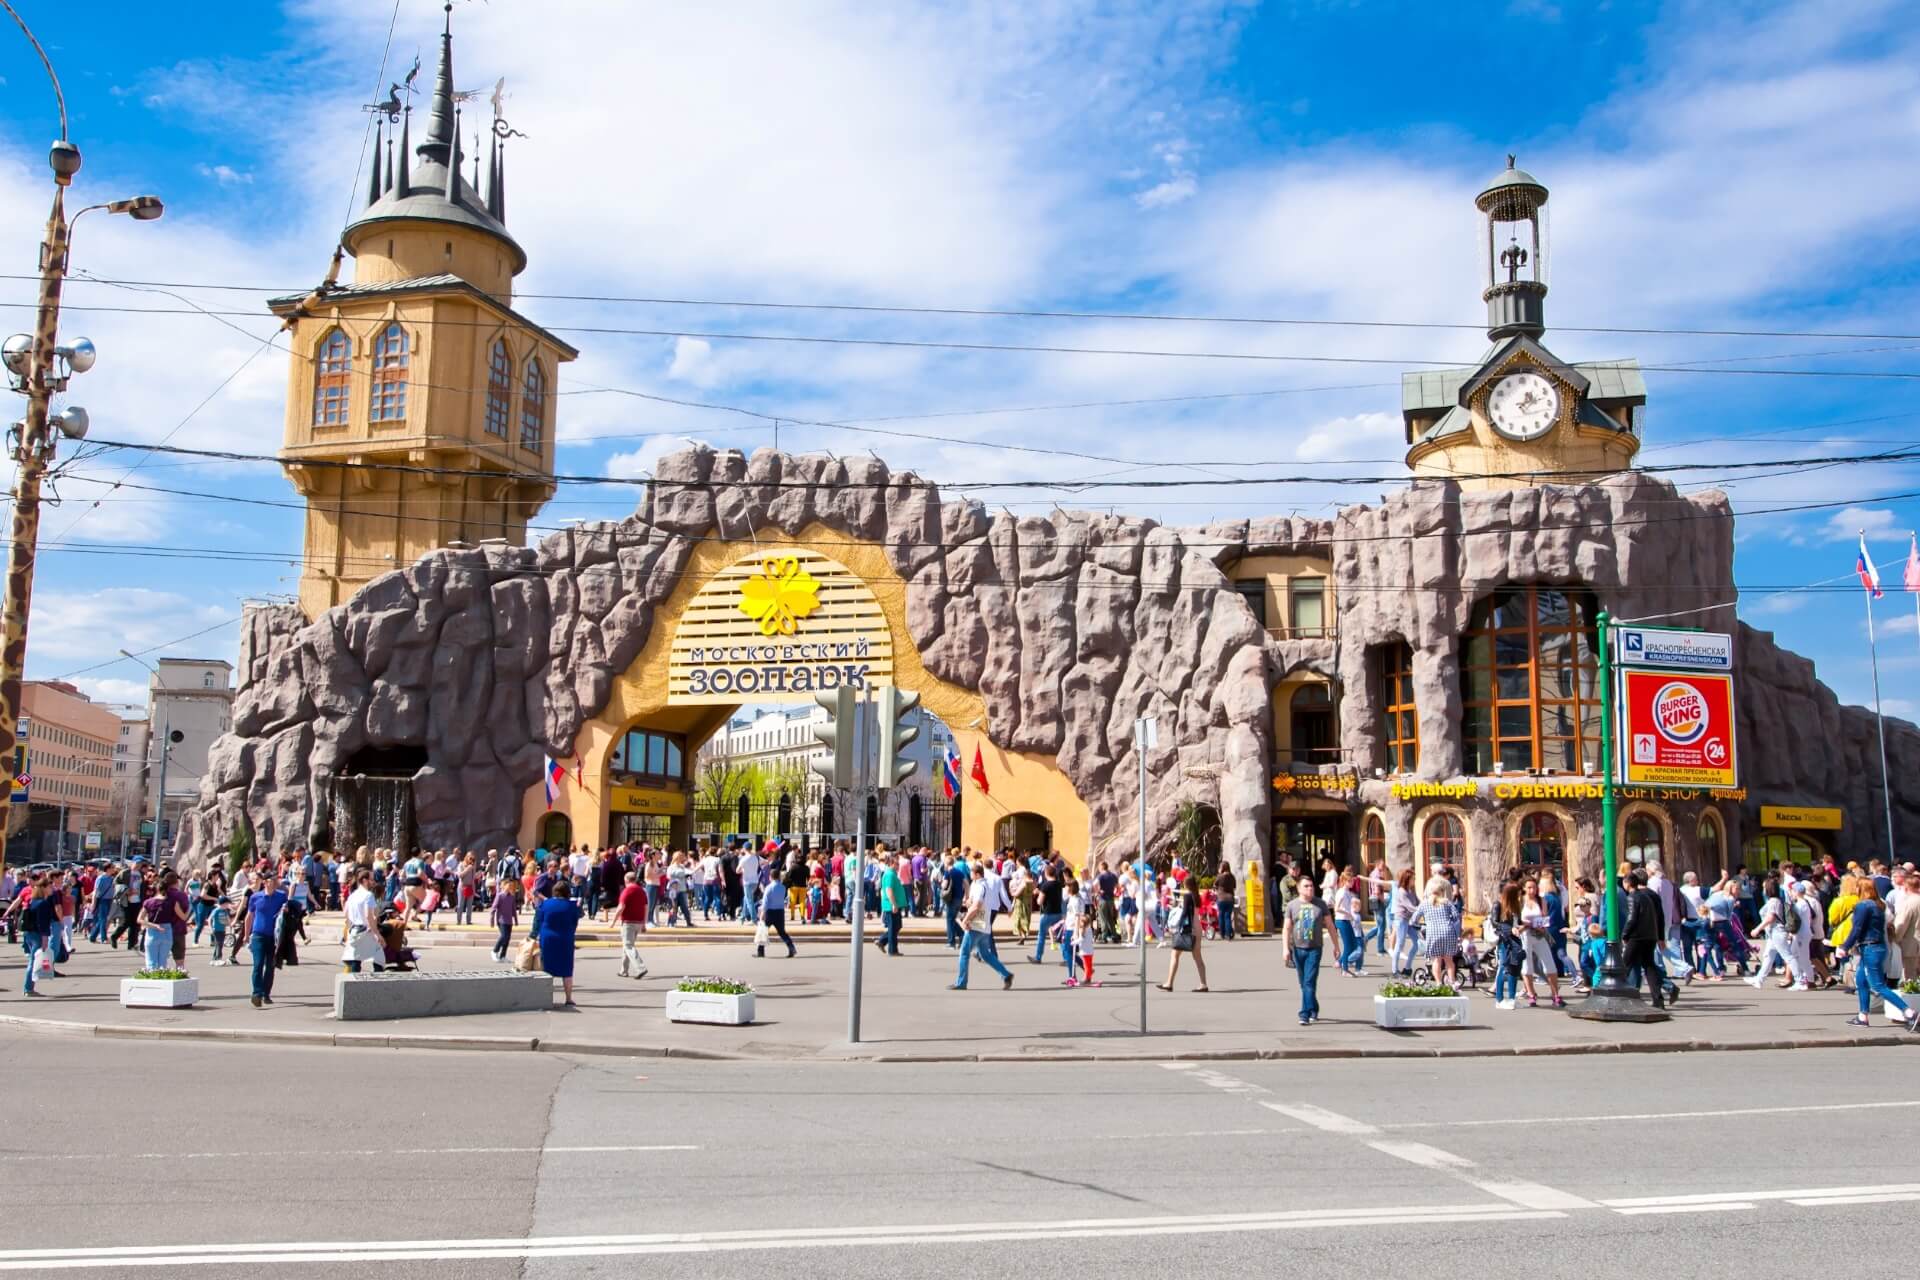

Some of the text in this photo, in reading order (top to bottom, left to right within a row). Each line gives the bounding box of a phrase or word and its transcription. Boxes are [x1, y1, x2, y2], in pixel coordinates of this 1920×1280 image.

[690, 637, 870, 662] МОСКОВСКИЙ
[1645, 643, 1726, 656] КРАСНОПРЕСНЕНСКАЯ
[1660, 696, 1699, 715] BURGER
[1662, 706, 1701, 729] KING
[1709, 744, 1725, 759] 24
[1391, 779, 1478, 800] #giftshop#
[1495, 783, 1604, 799] СУВЕНИРЫ
